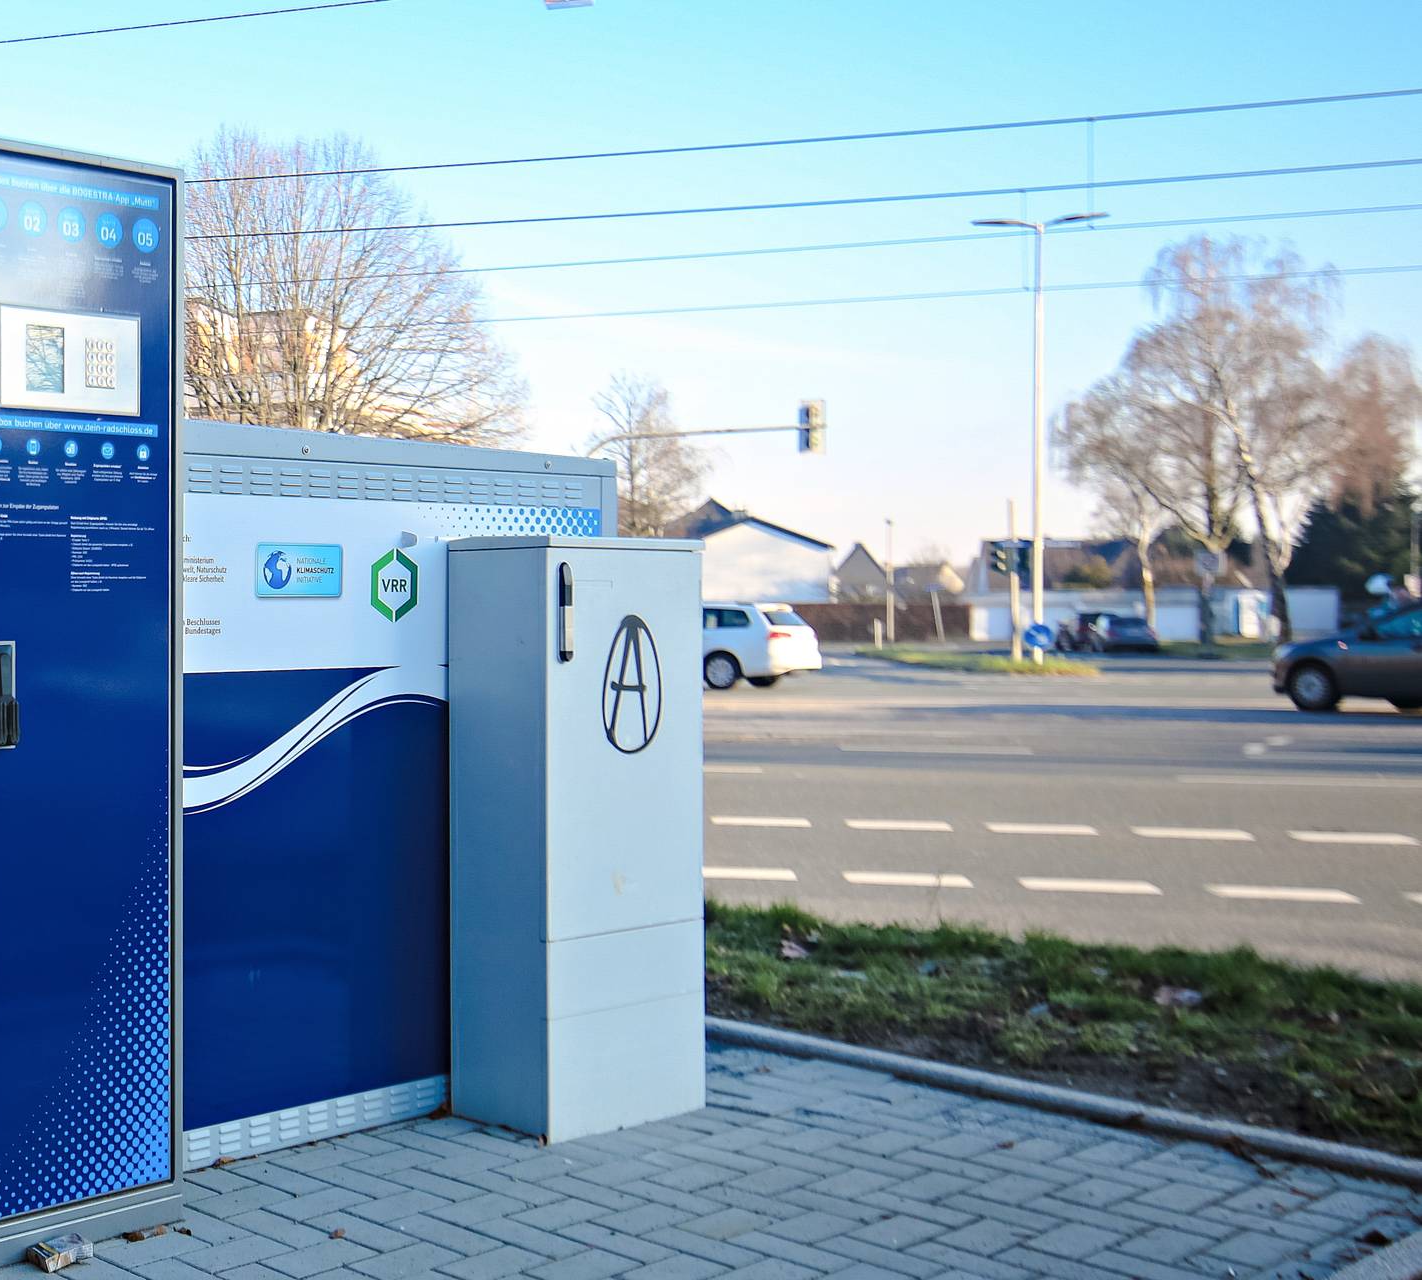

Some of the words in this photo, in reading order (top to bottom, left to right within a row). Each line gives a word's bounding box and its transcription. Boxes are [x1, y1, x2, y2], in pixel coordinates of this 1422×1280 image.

[24, 215, 40, 232] 02
[63, 221, 79, 237] 03
[100, 226, 116, 242] 04
[137, 232, 153, 248] 05
[14, 418, 42, 429] buchen
[44, 420, 63, 430] über
[64, 423, 153, 435] www.dein-radschloss.de
[296, 557, 327, 565] NATIONALE
[196, 566, 227, 574] Naturschutz
[296, 567, 335, 575] KLIMASCHUTZ
[199, 575, 225, 583] Sicherheit
[296, 576, 323, 584] INITIATIVE
[382, 579, 407, 593] VRR
[186, 618, 221, 626] Beschlusses
[185, 627, 221, 636] Bundestages
